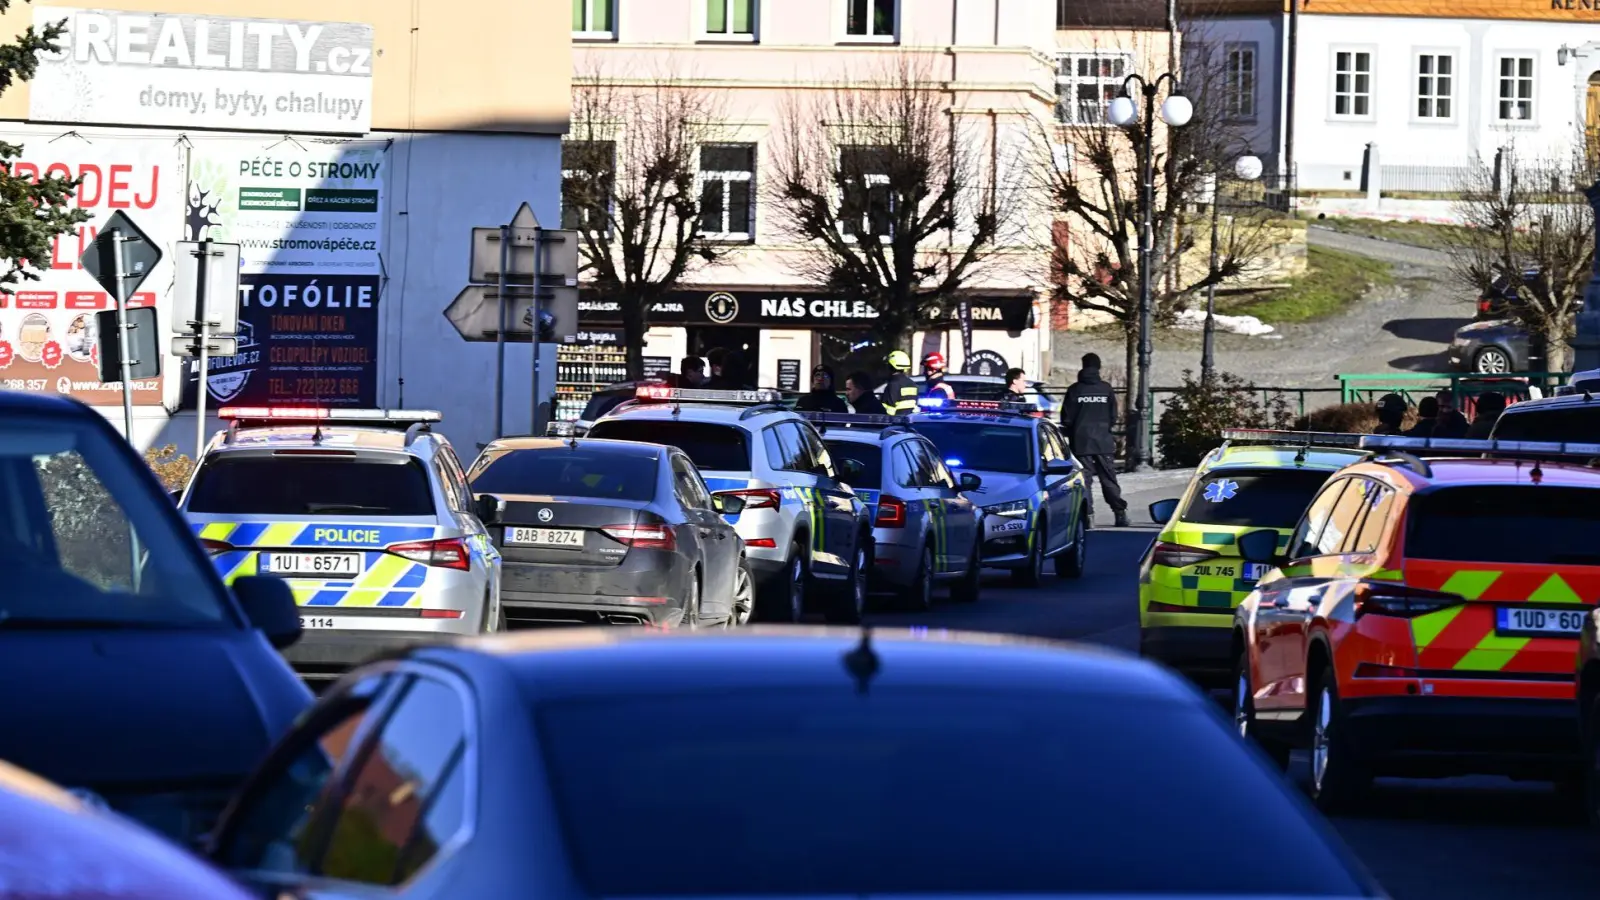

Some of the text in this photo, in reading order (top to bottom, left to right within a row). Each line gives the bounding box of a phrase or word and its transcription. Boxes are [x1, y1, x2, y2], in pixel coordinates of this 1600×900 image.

[139, 84, 363, 121] domy, byty, chalupy
[239, 156, 380, 179] PÉČE O STROMY
[333, 221, 377, 230] ODBORNOST
[238, 237, 377, 253] www.stromovápéče.cz
[239, 279, 372, 308] TOFÓLIE
[761, 297, 806, 317] NÁŠ
[27, 379, 48, 391] 357
[296, 377, 315, 395] 722
[314, 528, 380, 544] POLICIE
[515, 529, 578, 544] 8AB 8274
[274, 555, 351, 571] 1UI 6571
[1194, 565, 1213, 576] ZUL
[1216, 566, 1235, 577] 745
[1255, 564, 1273, 578] 1U
[310, 618, 333, 628] 114
[1513, 610, 1581, 630] 1UD 60
